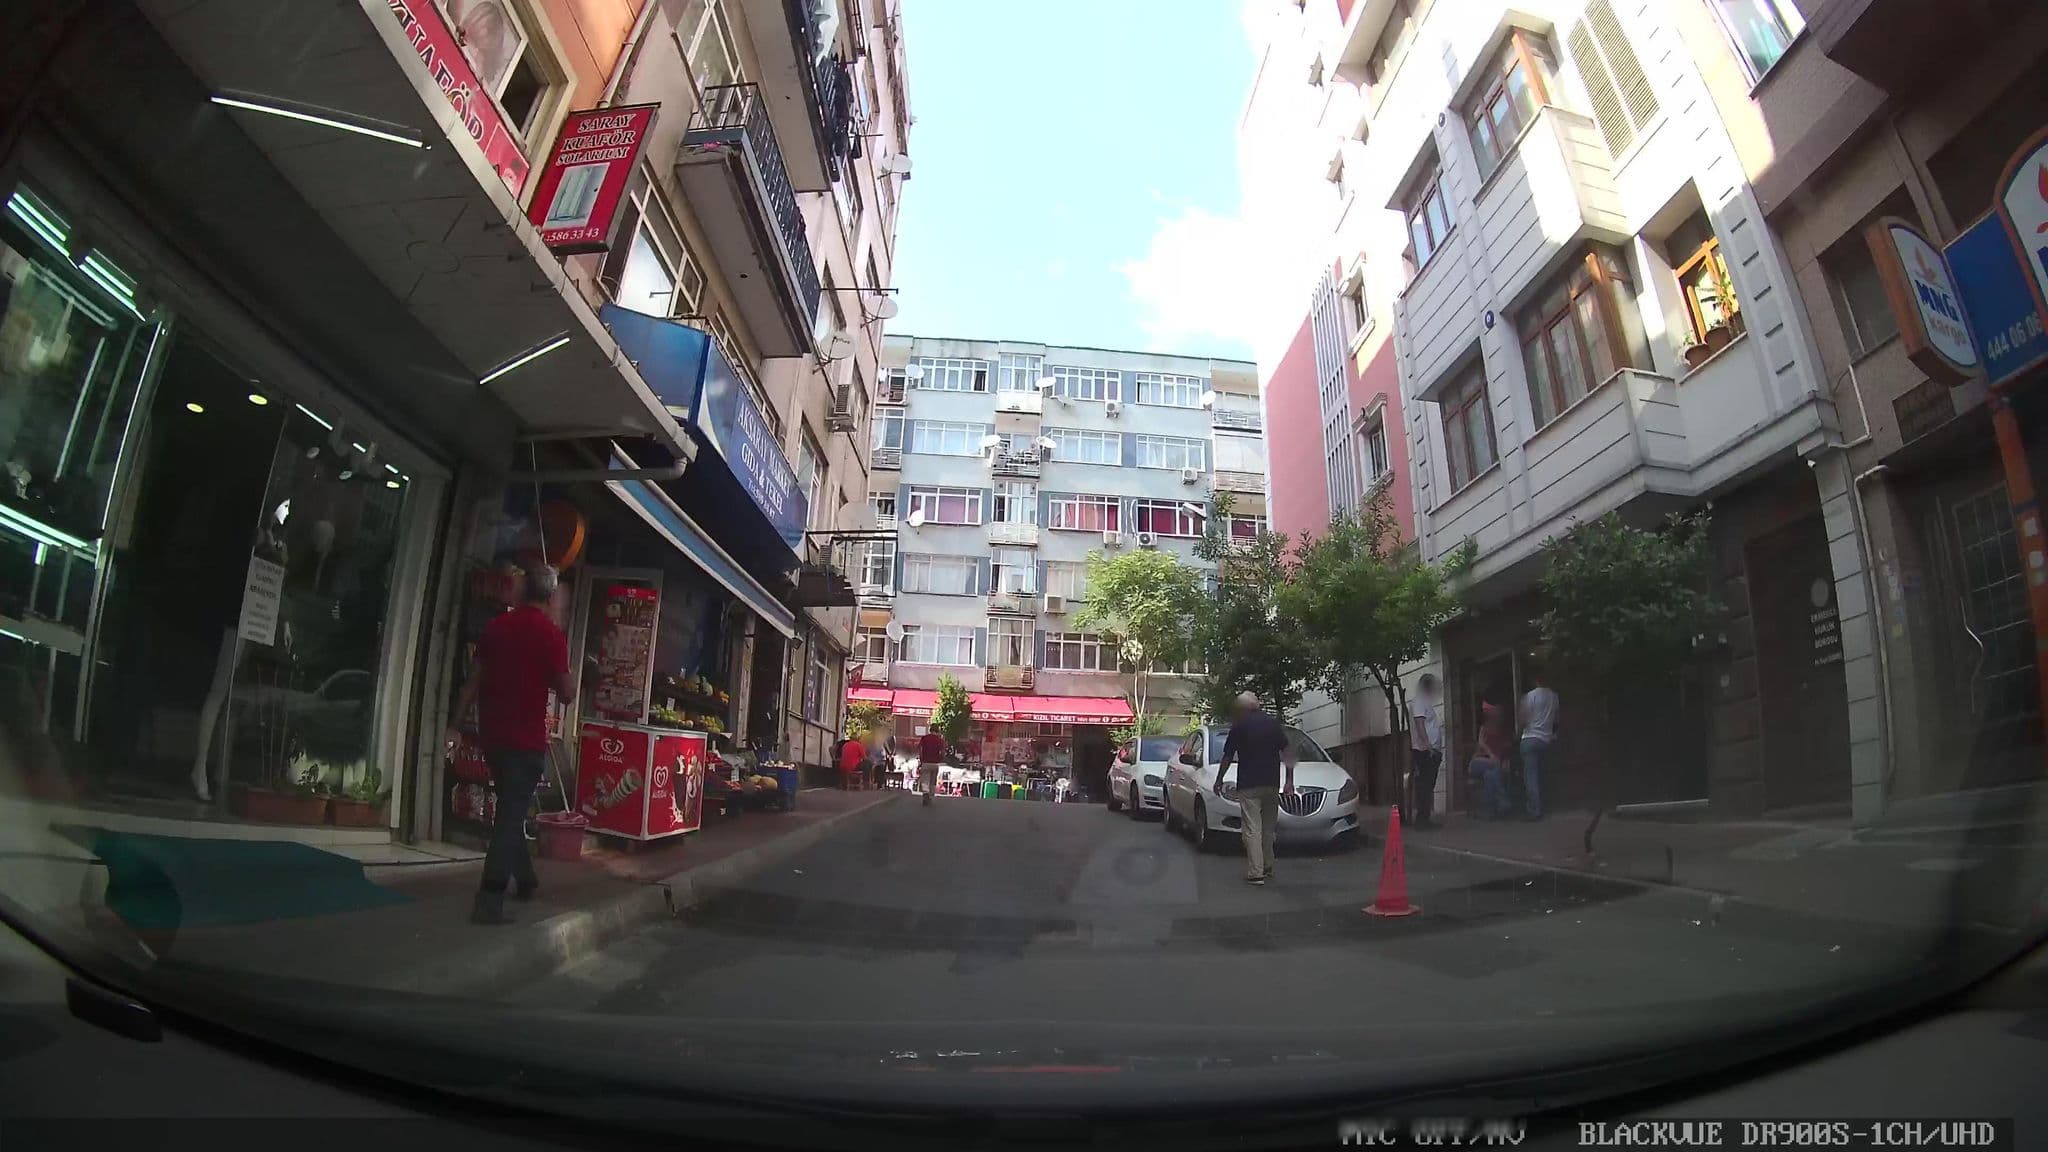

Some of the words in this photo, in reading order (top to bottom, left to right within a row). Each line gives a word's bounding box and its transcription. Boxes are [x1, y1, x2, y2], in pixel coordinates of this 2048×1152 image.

[577, 113, 637, 133] SARAY
[560, 129, 636, 153] KUAFÖR
[555, 146, 631, 167] SOLARIUM
[570, 231, 585, 239] 33
[1987, 331, 2010, 361] 444
[741, 442, 760, 480] GIDA
[765, 476, 784, 516] TEKEL
